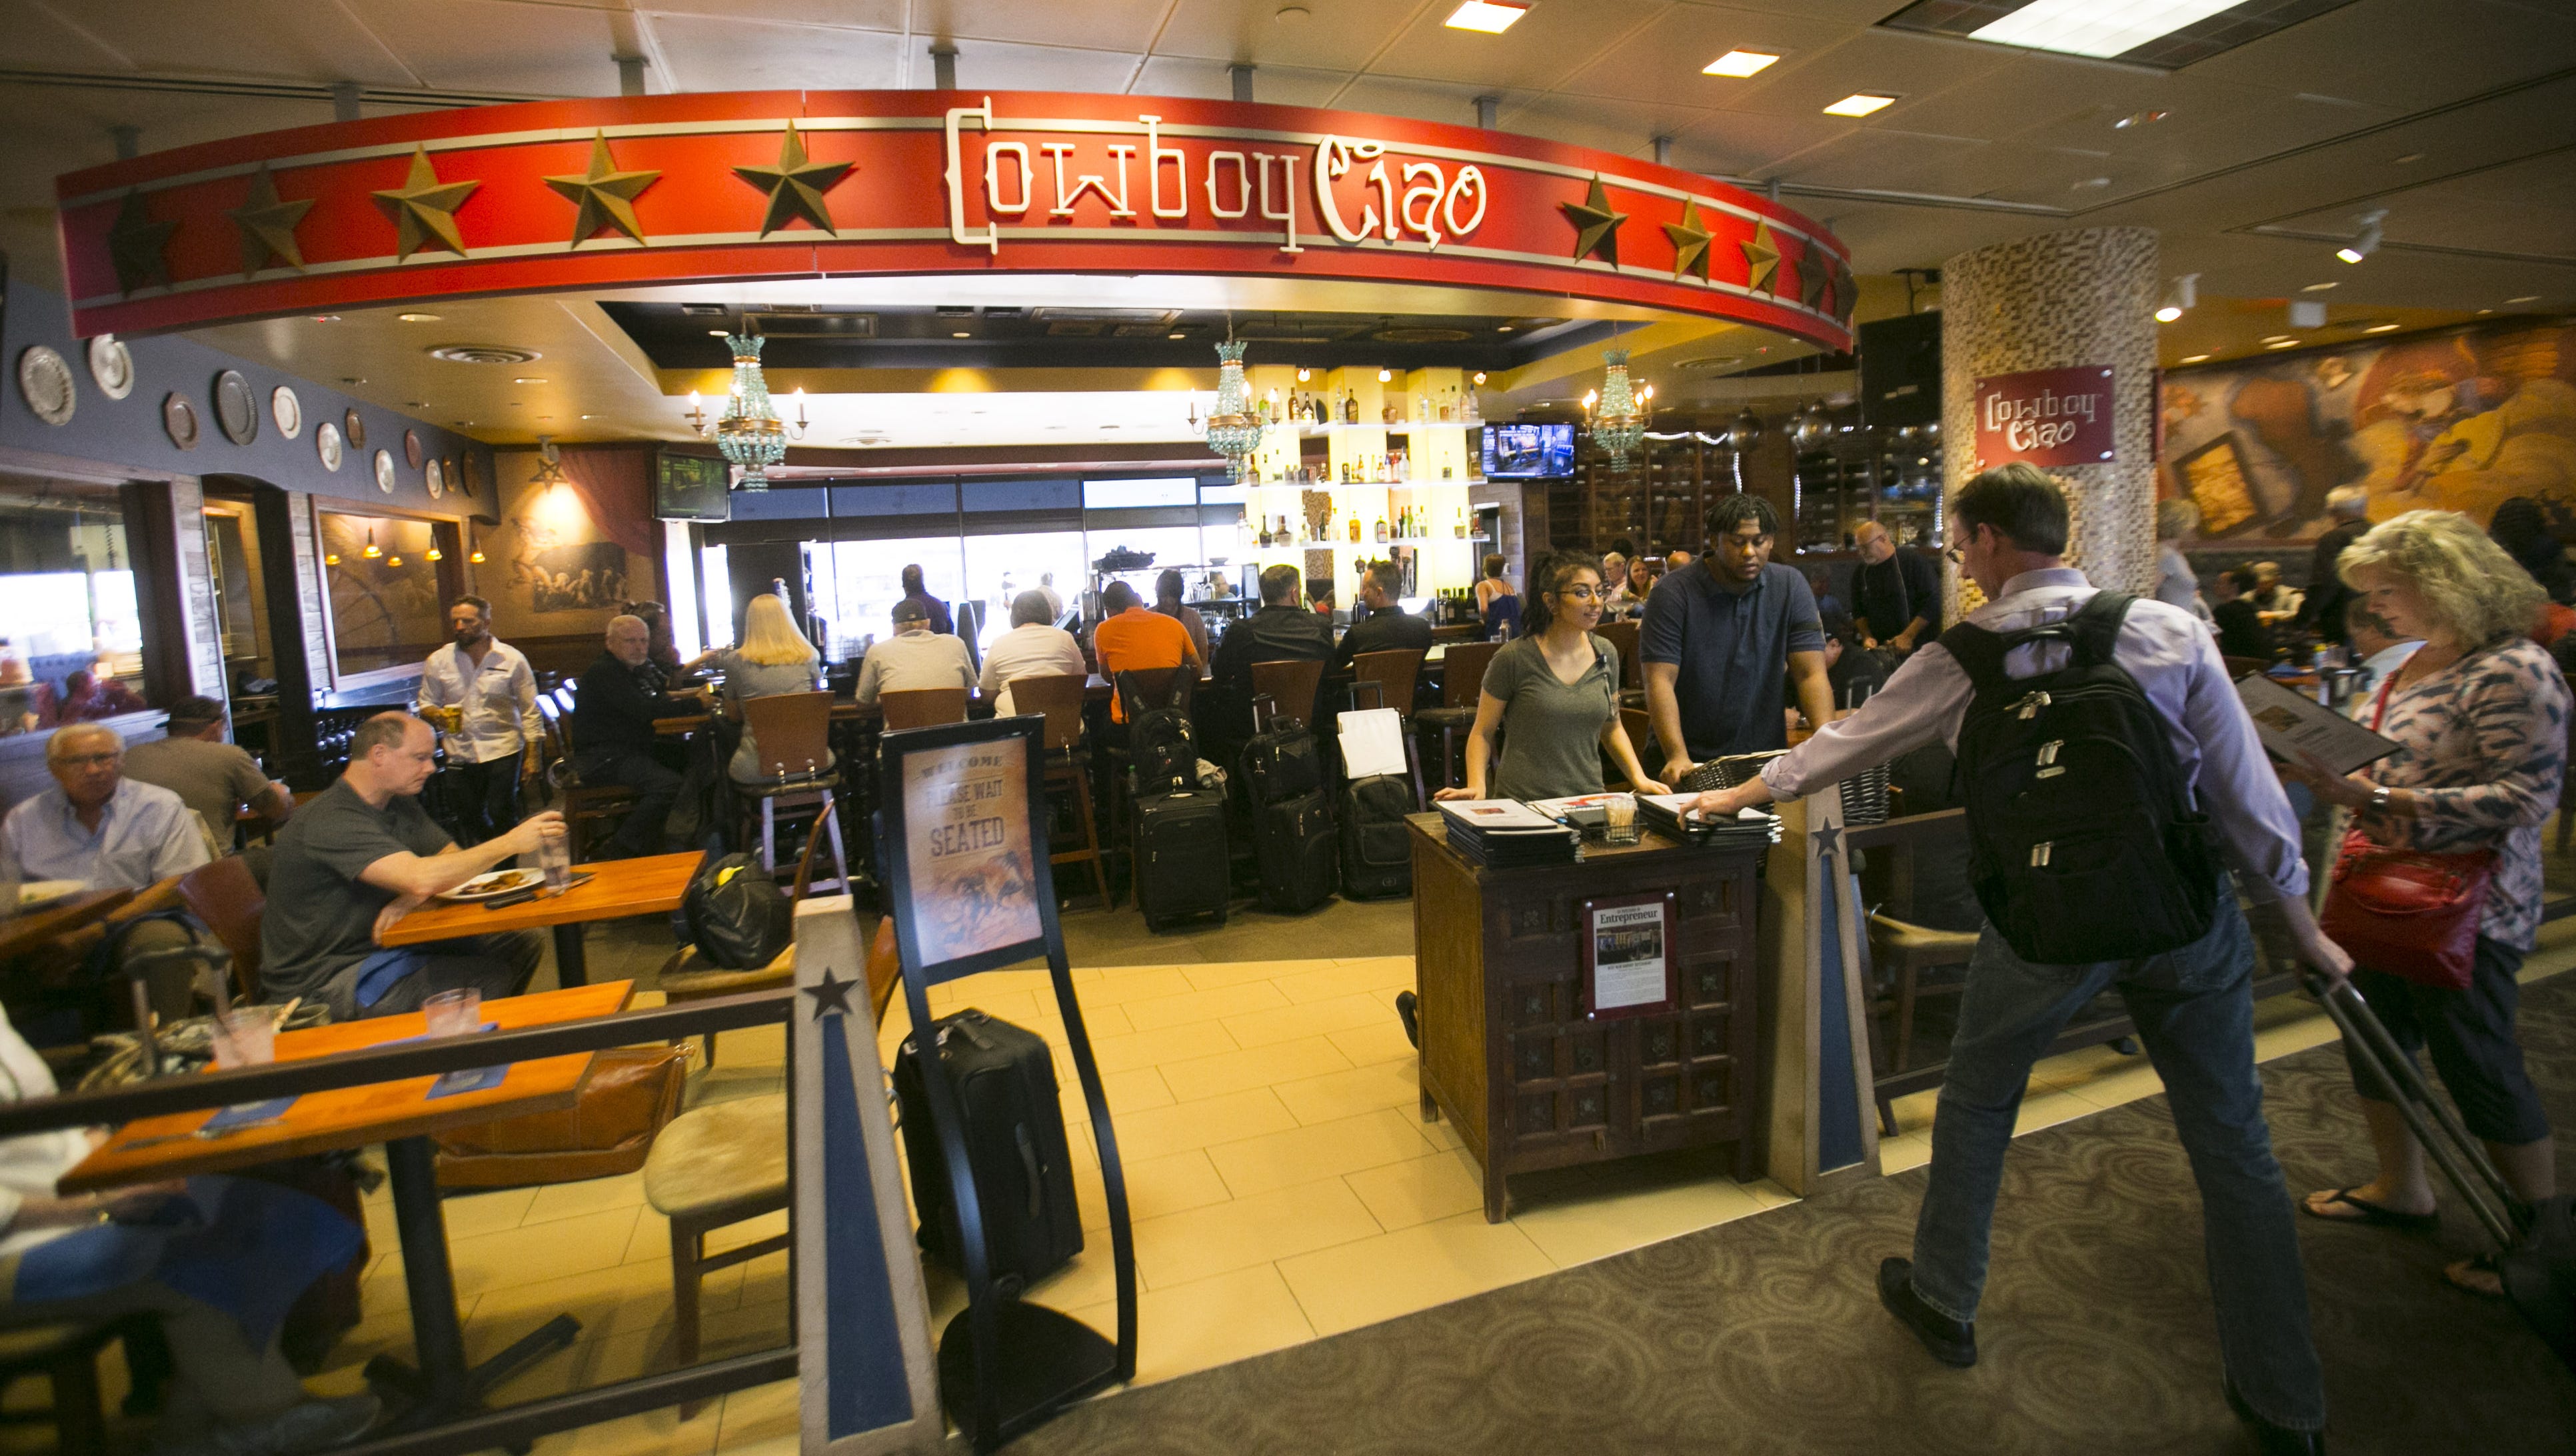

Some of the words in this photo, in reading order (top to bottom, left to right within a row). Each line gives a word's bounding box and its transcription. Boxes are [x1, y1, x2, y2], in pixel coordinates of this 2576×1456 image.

[945, 96, 1304, 256] Cowboy
[1314, 134, 1487, 251] Ciao
[1984, 389, 2103, 432] Cowboy
[2006, 419, 2076, 452] Ciao
[926, 785, 970, 808] EASE
[974, 779, 1003, 800] WAIT
[930, 816, 1004, 857] SEATED
[1600, 909, 1658, 924] Entrepreneur
